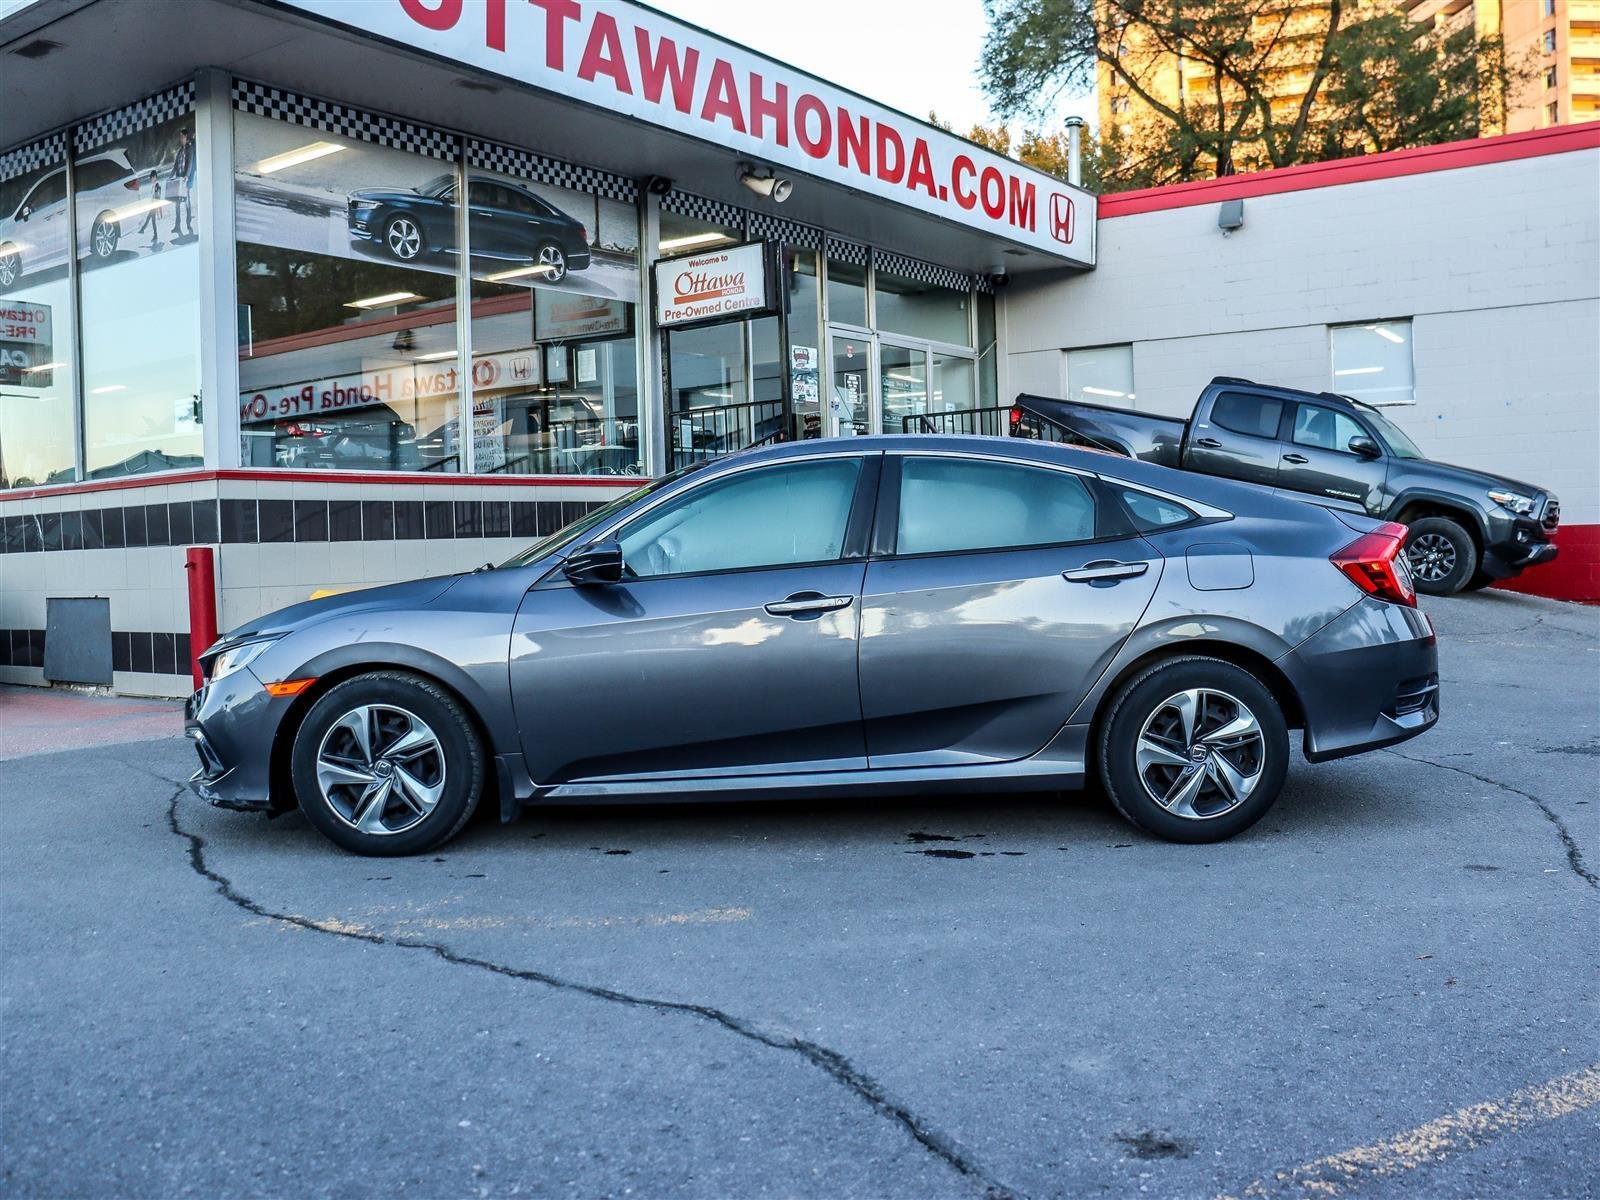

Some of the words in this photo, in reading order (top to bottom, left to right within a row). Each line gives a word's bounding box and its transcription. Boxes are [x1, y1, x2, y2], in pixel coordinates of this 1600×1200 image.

[688, 257, 720, 269] Welcome
[720, 255, 729, 263] to
[674, 271, 745, 296] Ottawa
[721, 286, 744, 297] HONDA
[664, 301, 722, 321] Pre-Owned
[724, 296, 761, 312] Centre
